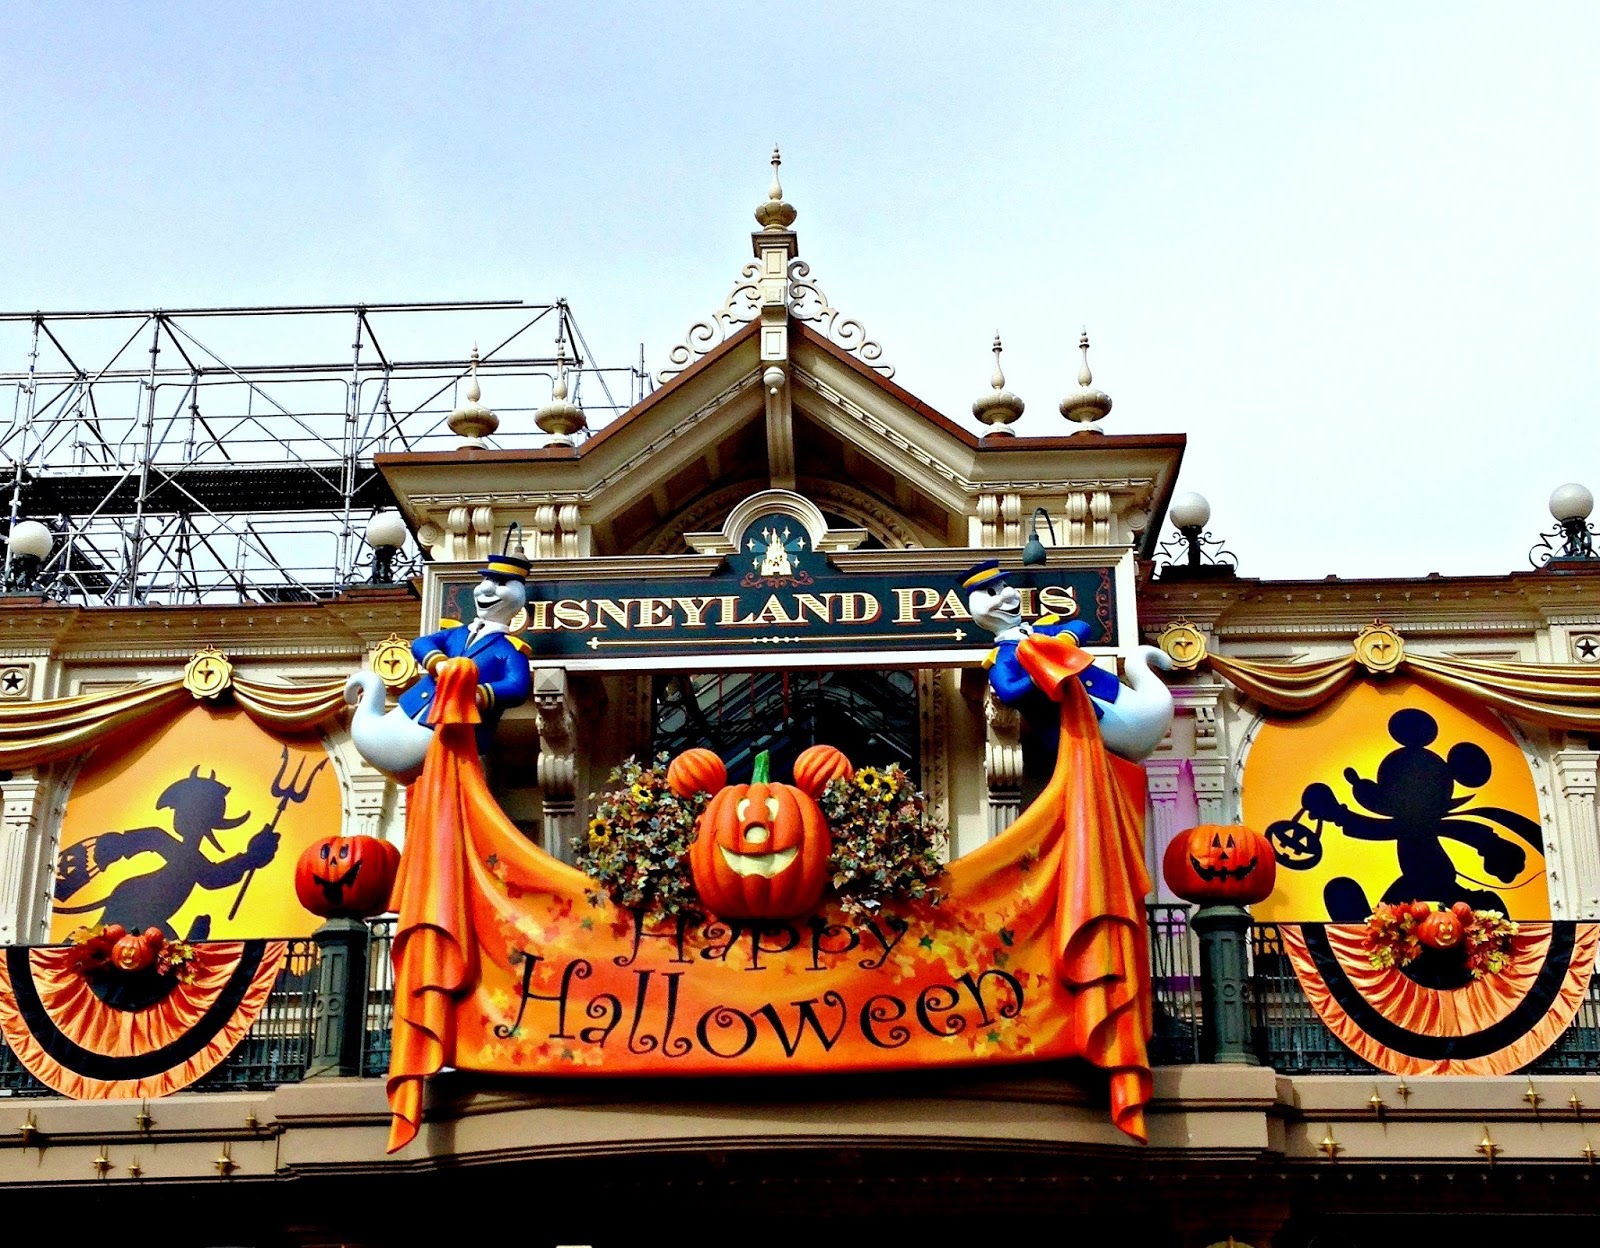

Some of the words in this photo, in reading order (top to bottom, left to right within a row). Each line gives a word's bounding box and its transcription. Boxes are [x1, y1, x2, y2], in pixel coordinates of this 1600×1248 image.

[892, 585, 1078, 625] PAIS
[613, 906, 908, 972] Happy
[493, 950, 1025, 1059] Halloween
